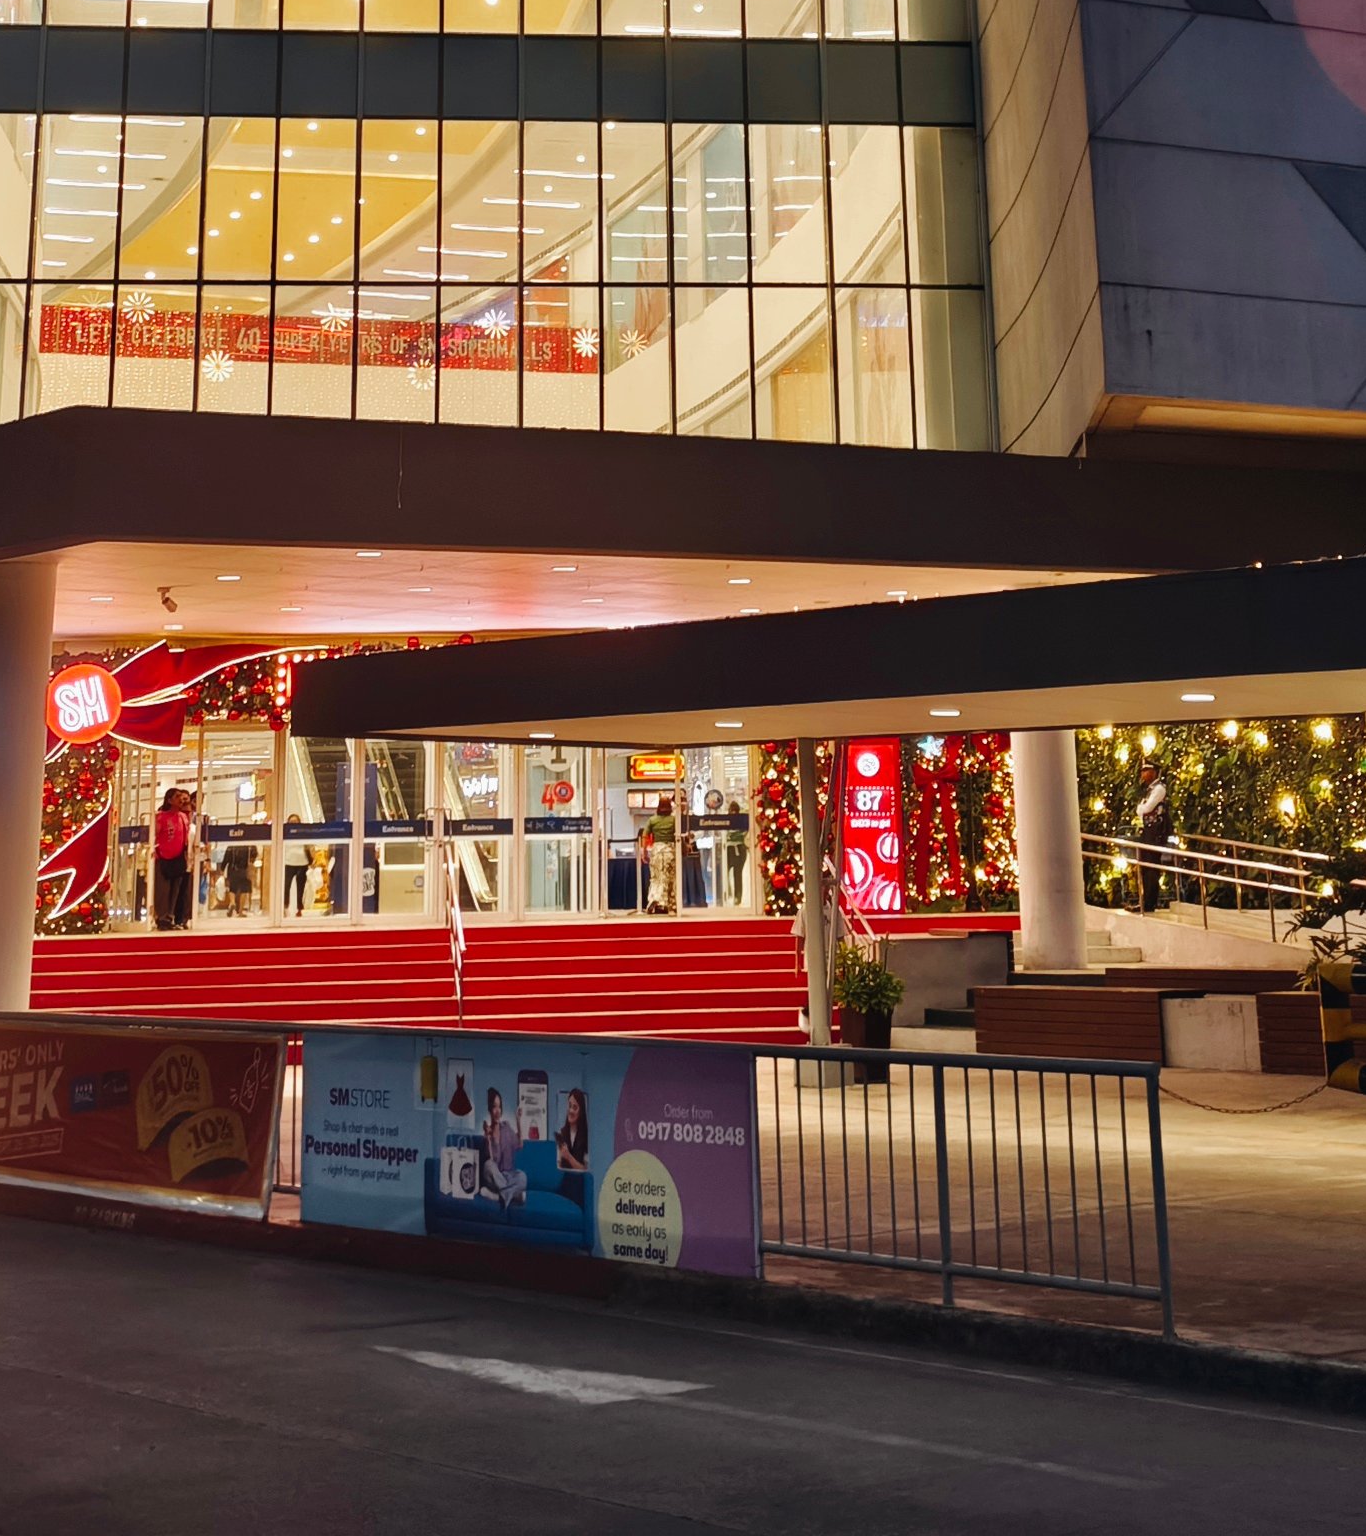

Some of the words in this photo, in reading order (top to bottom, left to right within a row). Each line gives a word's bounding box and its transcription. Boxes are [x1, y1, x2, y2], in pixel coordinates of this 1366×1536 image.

[237, 327, 261, 353] 40
[329, 334, 383, 355] YERS
[390, 336, 408, 354] OF
[448, 338, 553, 361] SUPERMALS
[54, 675, 109, 733] SM
[856, 790, 883, 812] 87
[382, 825, 414, 834] Entrance
[462, 823, 494, 832] Entrance
[24, 1040, 65, 1064] ONLY
[150, 1053, 200, 1111] 50%
[664, 1103, 690, 1119] Order
[691, 1104, 714, 1120] from
[323, 1119, 340, 1134] Shop
[348, 1122, 363, 1133] chat
[364, 1123, 379, 1135] with
[386, 1125, 399, 1137] real
[638, 1120, 671, 1141] 0917
[673, 1122, 703, 1143] 808
[705, 1125, 745, 1146] 2848
[304, 1134, 361, 1158] Personal
[362, 1139, 419, 1166] Shopper
[344, 1165, 360, 1177] from
[361, 1169, 375, 1181] your
[614, 1176, 631, 1194] Get
[633, 1180, 666, 1197] orders
[615, 1198, 665, 1218] delivered
[612, 1222, 624, 1235] as
[626, 1220, 652, 1242] early
[654, 1226, 667, 1240] as
[613, 1244, 643, 1258] same
[645, 1245, 669, 1263] day!
